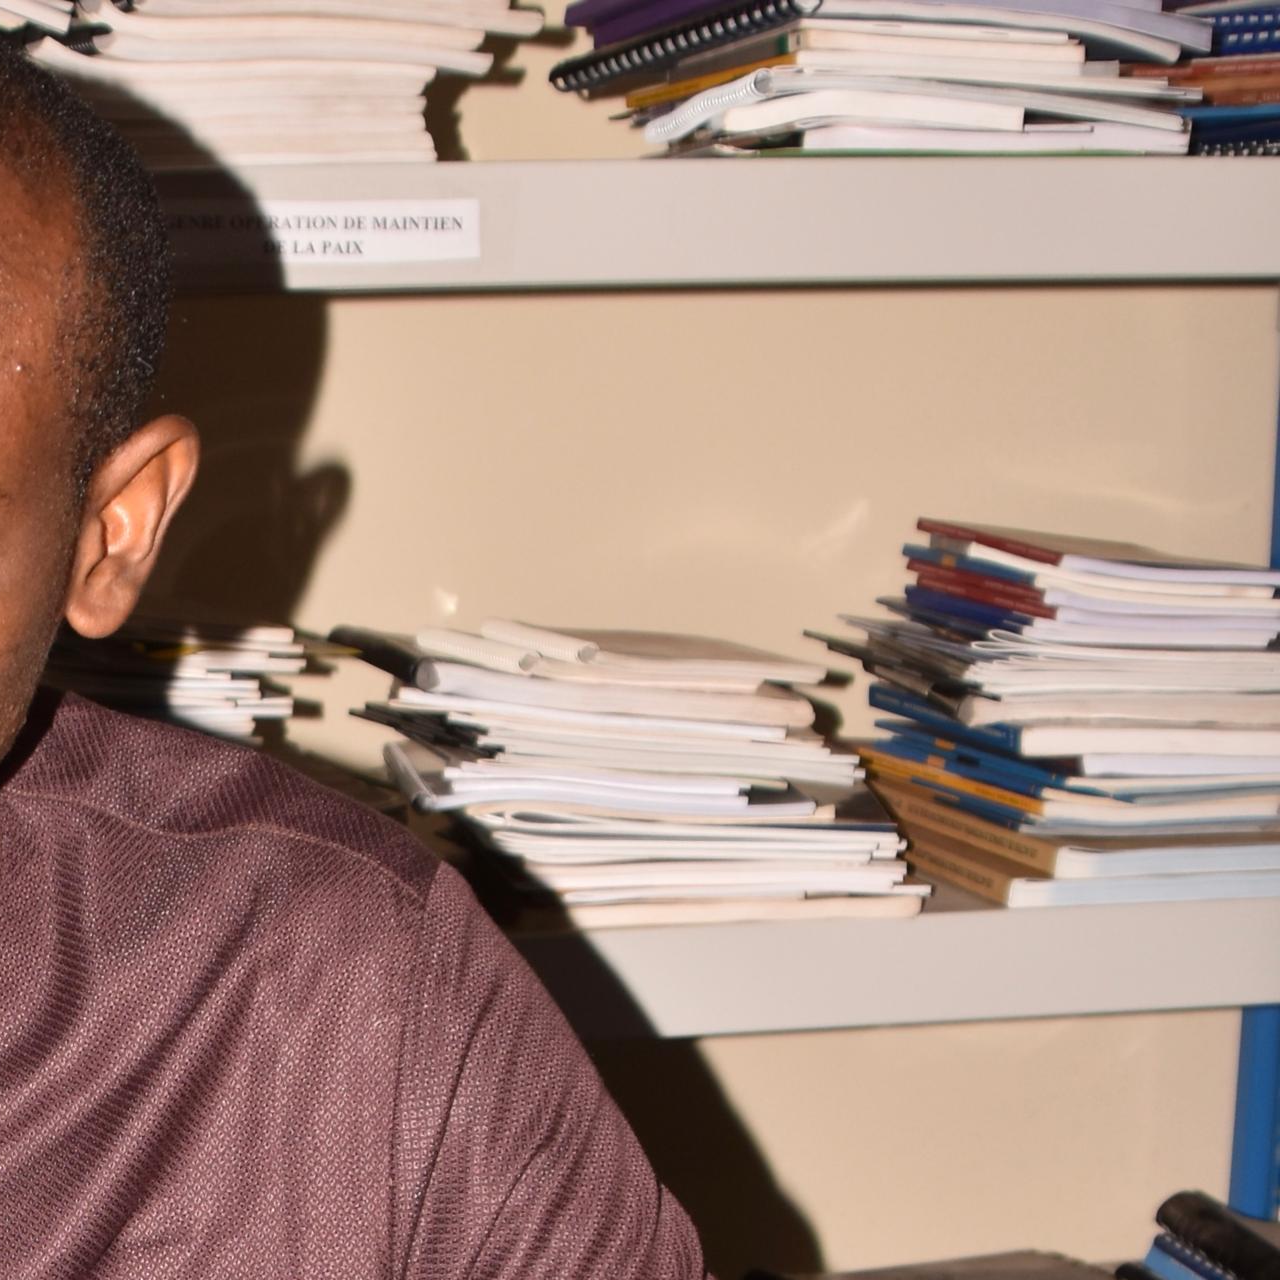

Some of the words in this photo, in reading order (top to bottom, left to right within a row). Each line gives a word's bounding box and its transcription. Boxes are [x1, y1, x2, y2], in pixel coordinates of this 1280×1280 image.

[343, 215, 368, 230] DE
[372, 215, 464, 230] MAINTIEN
[263, 241, 286, 255] DE
[293, 241, 316, 254] LA
[321, 240, 365, 255] PAIX
